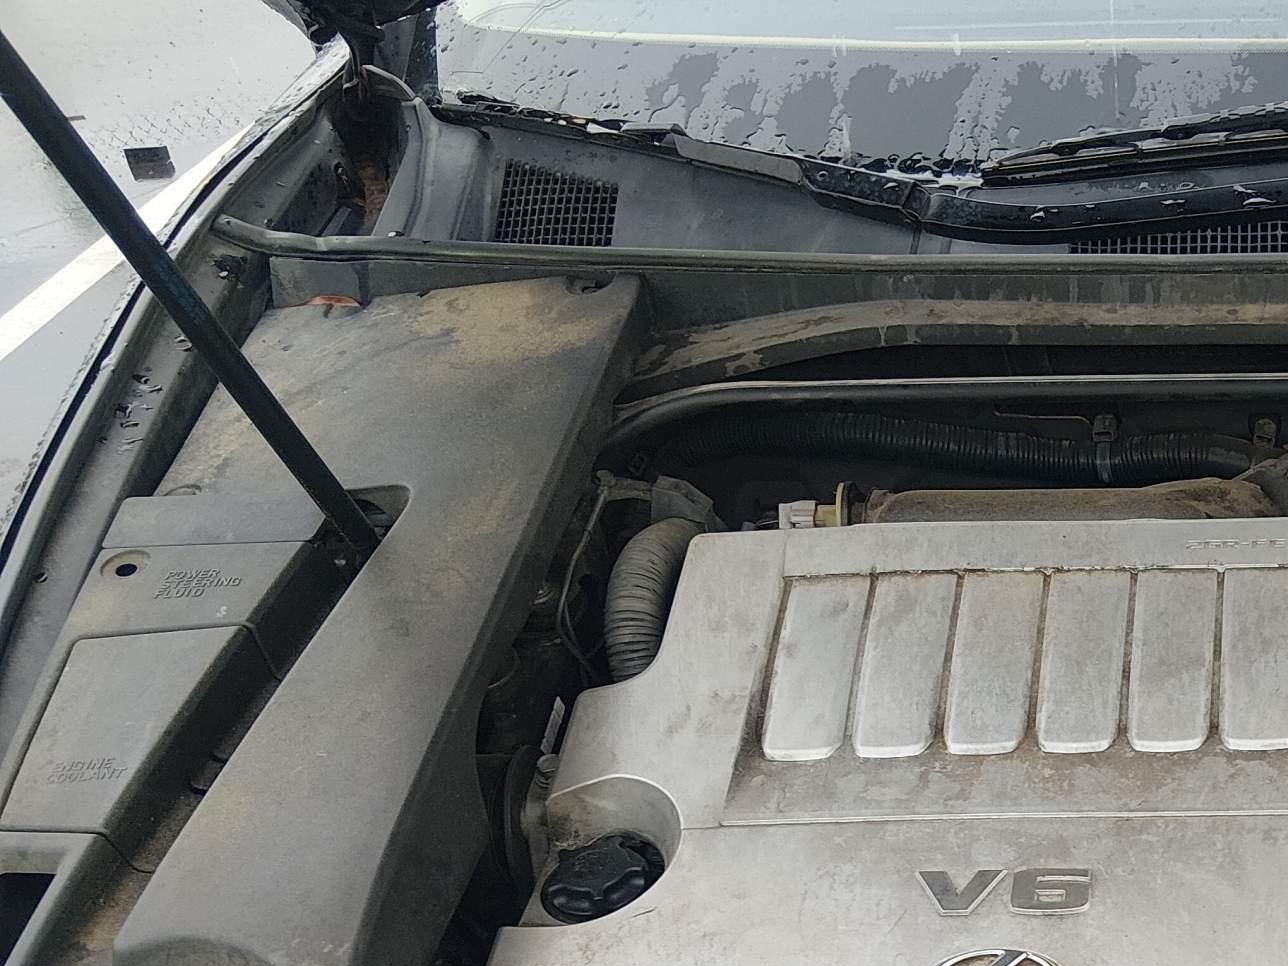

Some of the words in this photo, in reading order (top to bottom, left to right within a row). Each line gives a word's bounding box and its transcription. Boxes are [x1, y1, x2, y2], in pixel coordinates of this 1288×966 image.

[1185, 537, 1288, 551] 2GR-FE
[163, 568, 222, 580] POWER
[159, 577, 243, 590] STEERING
[154, 587, 206, 600] FLUID
[52, 757, 116, 772] ENGINE
[46, 767, 129, 785] COOLANT
[914, 868, 1094, 917] V6
